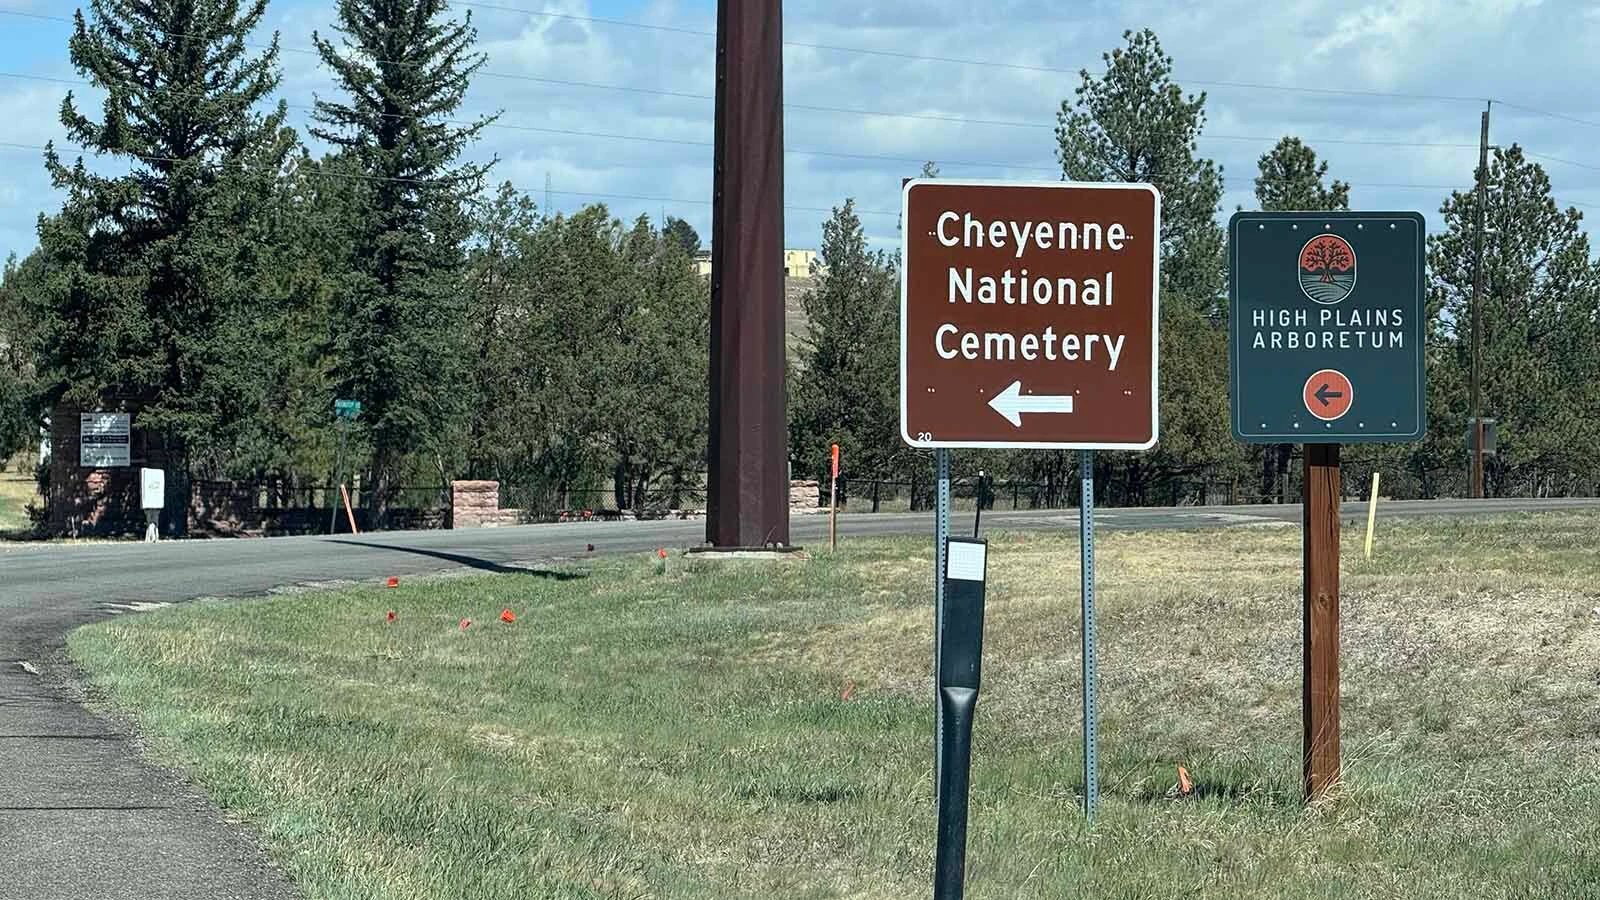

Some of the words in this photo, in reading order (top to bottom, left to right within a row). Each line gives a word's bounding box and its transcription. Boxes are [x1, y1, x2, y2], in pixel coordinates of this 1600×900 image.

[936, 210, 1127, 258] Cheyenne
[948, 267, 1113, 306] National
[1252, 309, 1308, 327] HIGH
[1320, 309, 1404, 327] PLAINS
[935, 323, 1126, 371] Cemetery
[1252, 331, 1404, 349] ARBORETUM
[918, 431, 933, 442] 20
